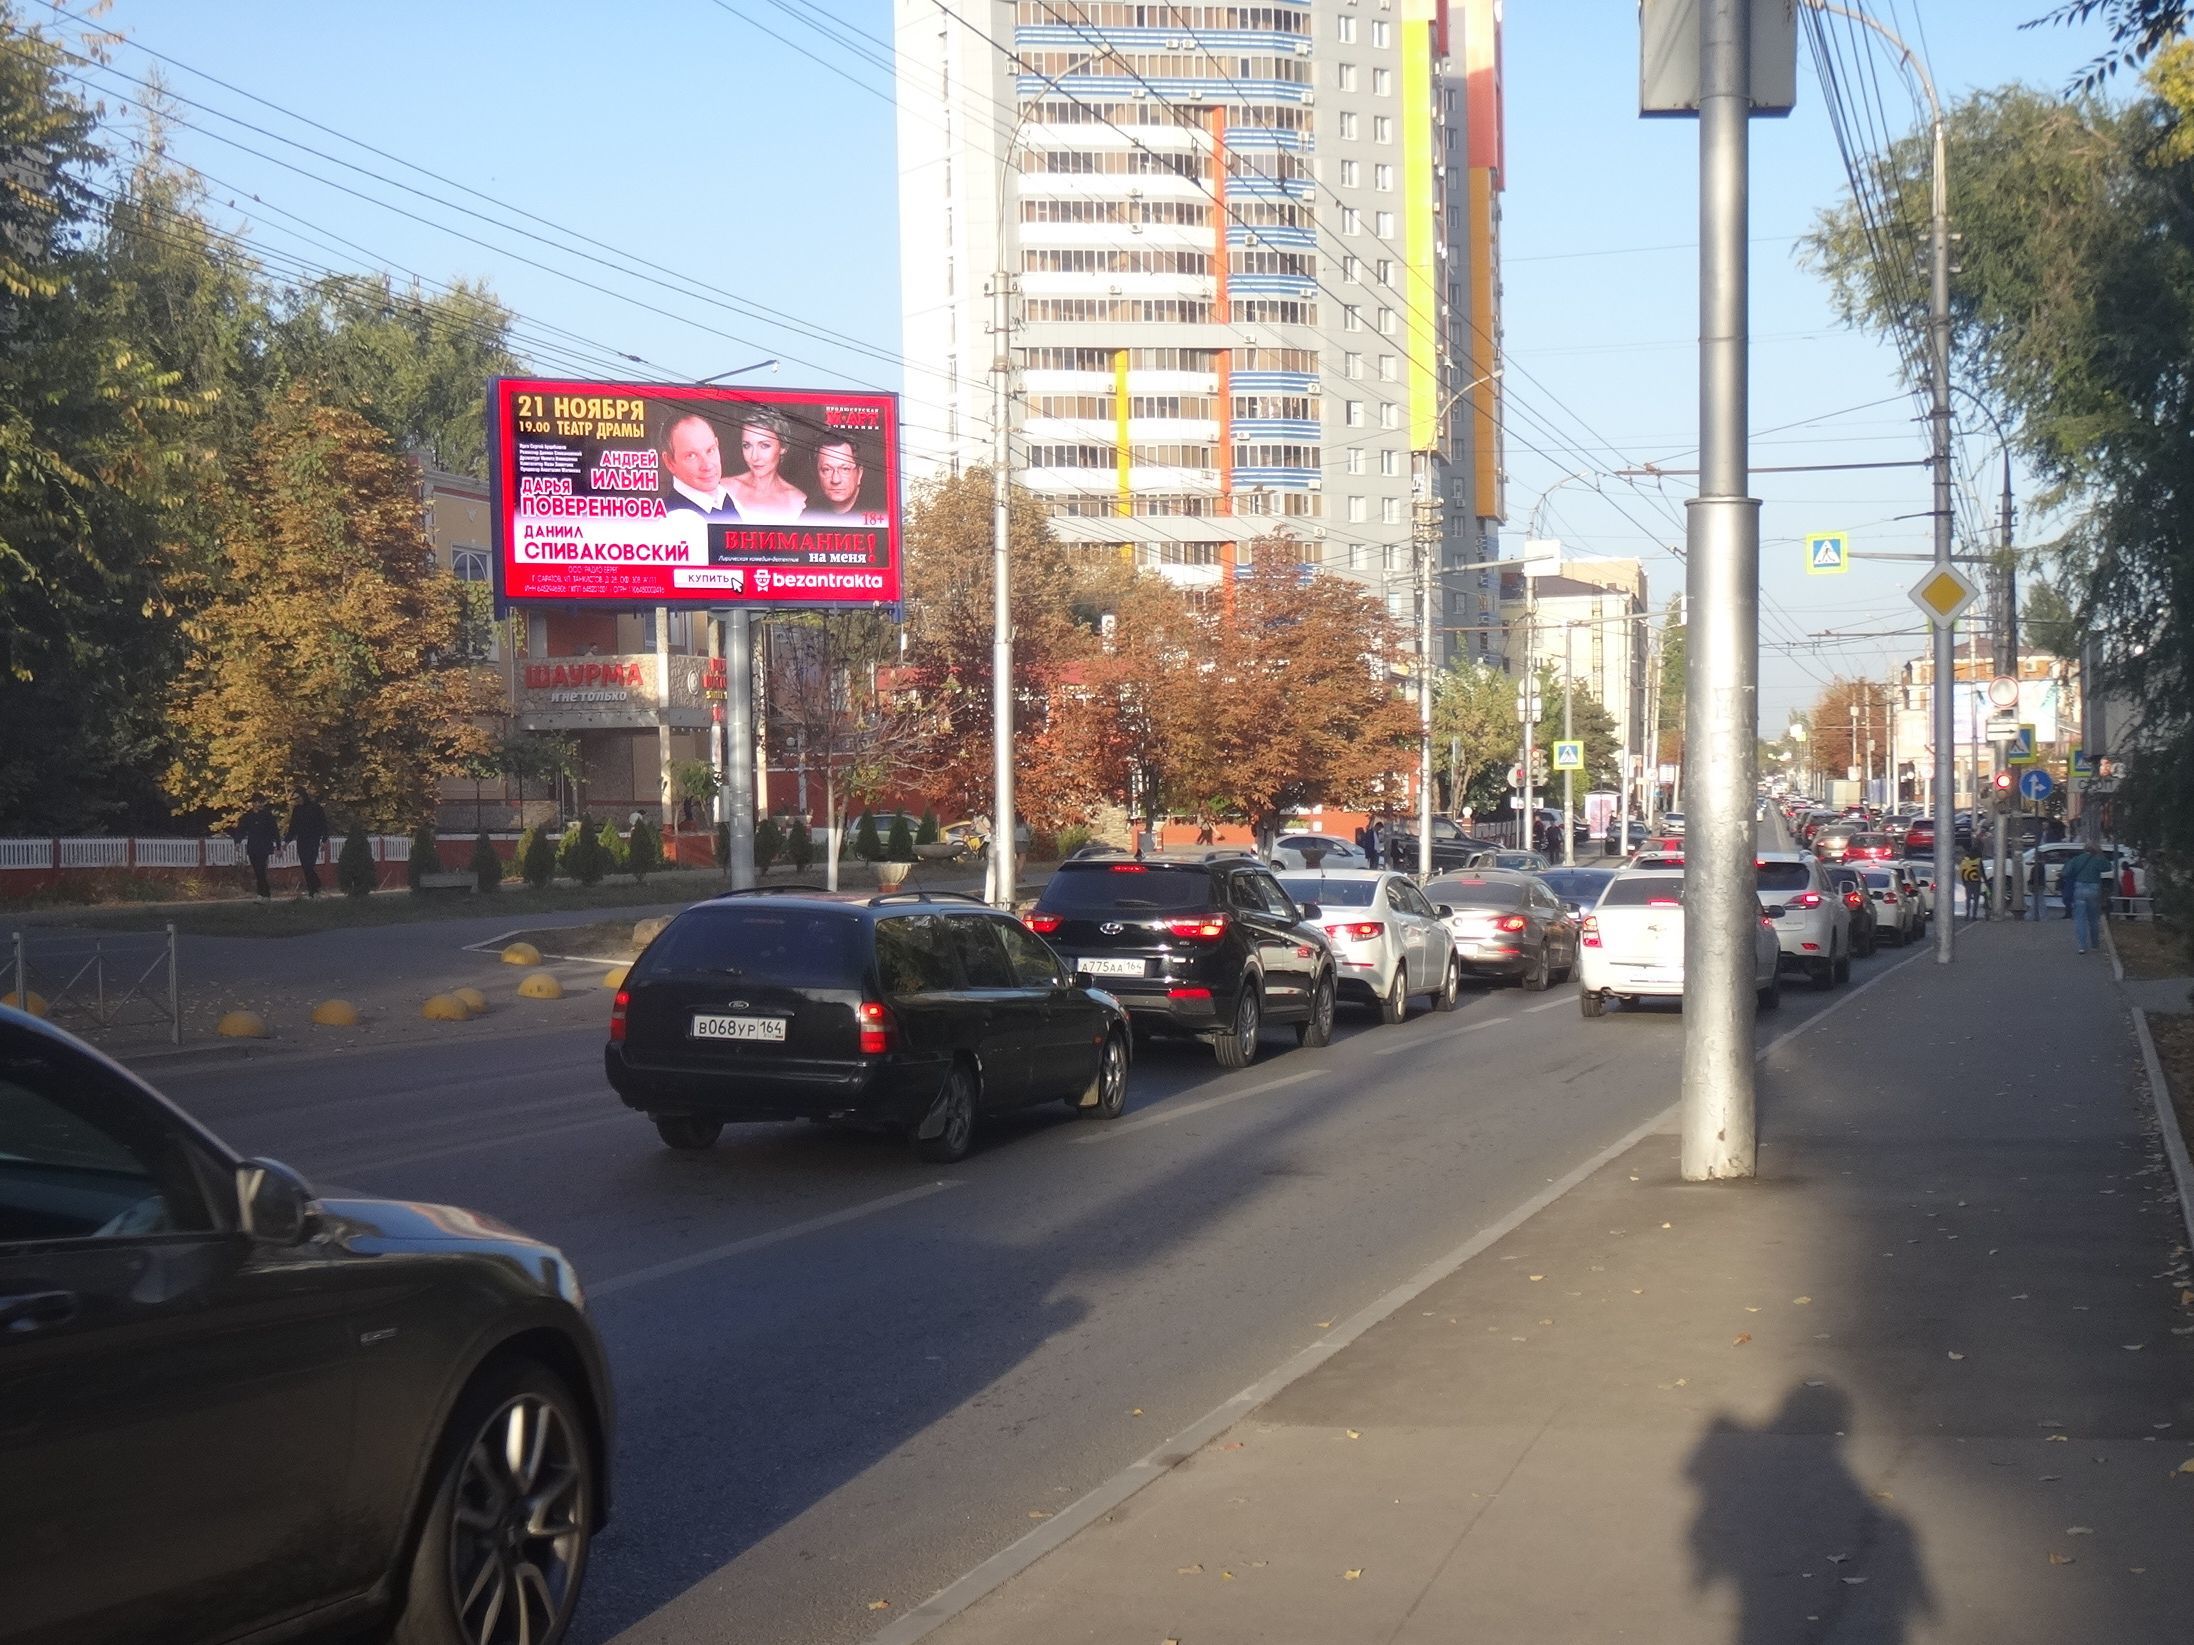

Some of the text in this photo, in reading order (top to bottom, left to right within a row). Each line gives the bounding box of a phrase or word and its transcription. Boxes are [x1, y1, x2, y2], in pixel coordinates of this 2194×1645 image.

[518, 395, 645, 421] 21 НОЯБРЯ
[518, 420, 645, 439] 19.00 ТЕАТР ДРАМЫ
[602, 450, 658, 468] АНДРЕЙ
[521, 478, 572, 495] ДАРЬЯ
[591, 469, 658, 489] ИЛЬИН
[521, 496, 667, 518] ПОВЕРЕННОВА
[862, 511, 885, 526] 18+
[524, 525, 584, 539] ДАНИИЛ
[524, 541, 690, 562] СПИВАКОВСКИЙ
[724, 530, 877, 563] ВНИМАНИЕ!
[809, 552, 867, 564] на меня
[688, 574, 730, 583] КУПИТЬ
[773, 572, 883, 589] bezantrakta
[525, 663, 644, 689] ШАУРМА
[578, 691, 628, 701] только
[1081, 961, 1123, 973] А775АА
[698, 1019, 782, 1036] В068УР 164
